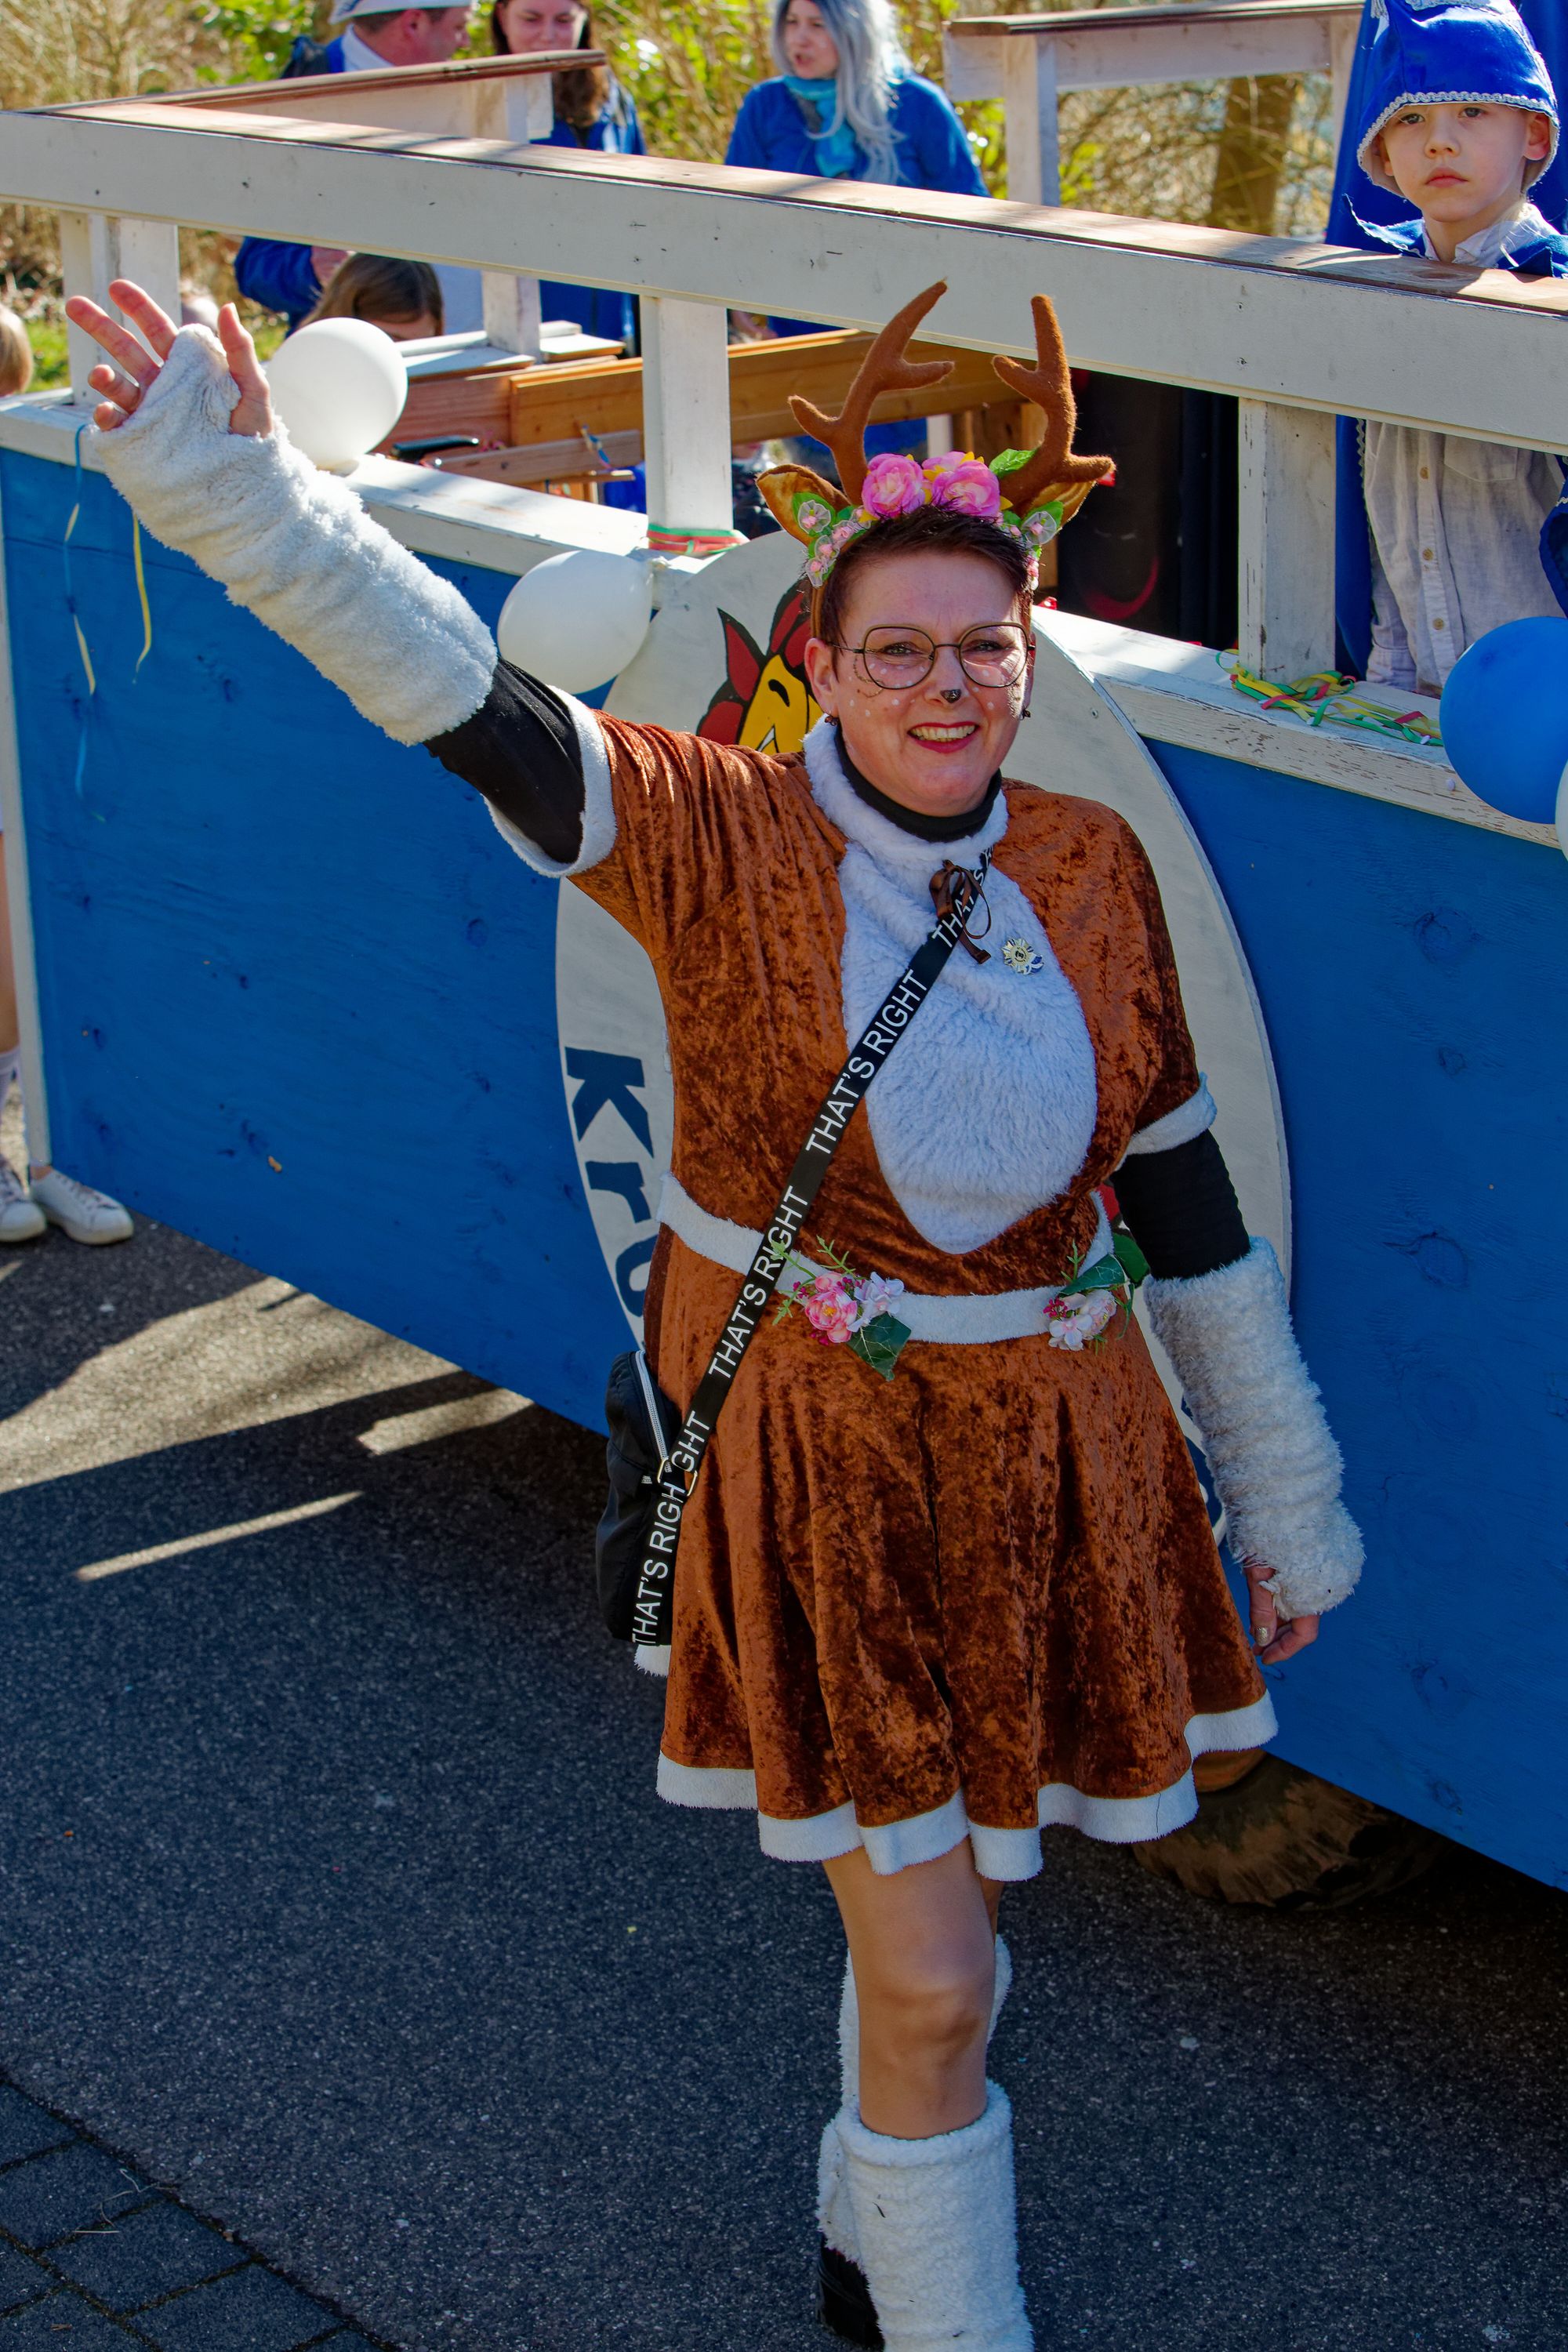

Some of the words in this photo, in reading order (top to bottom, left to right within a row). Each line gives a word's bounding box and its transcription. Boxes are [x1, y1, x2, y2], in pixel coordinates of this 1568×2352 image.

[931, 869, 985, 948] THAS
[805, 1056, 875, 1154] THAT'S
[863, 969, 927, 1055] RIGHT
[708, 1283, 767, 1378] THAT'S
[671, 1410, 710, 1472] GHT
[648, 1481, 686, 1553] RIGH
[632, 1559, 669, 1645] THAT'S
